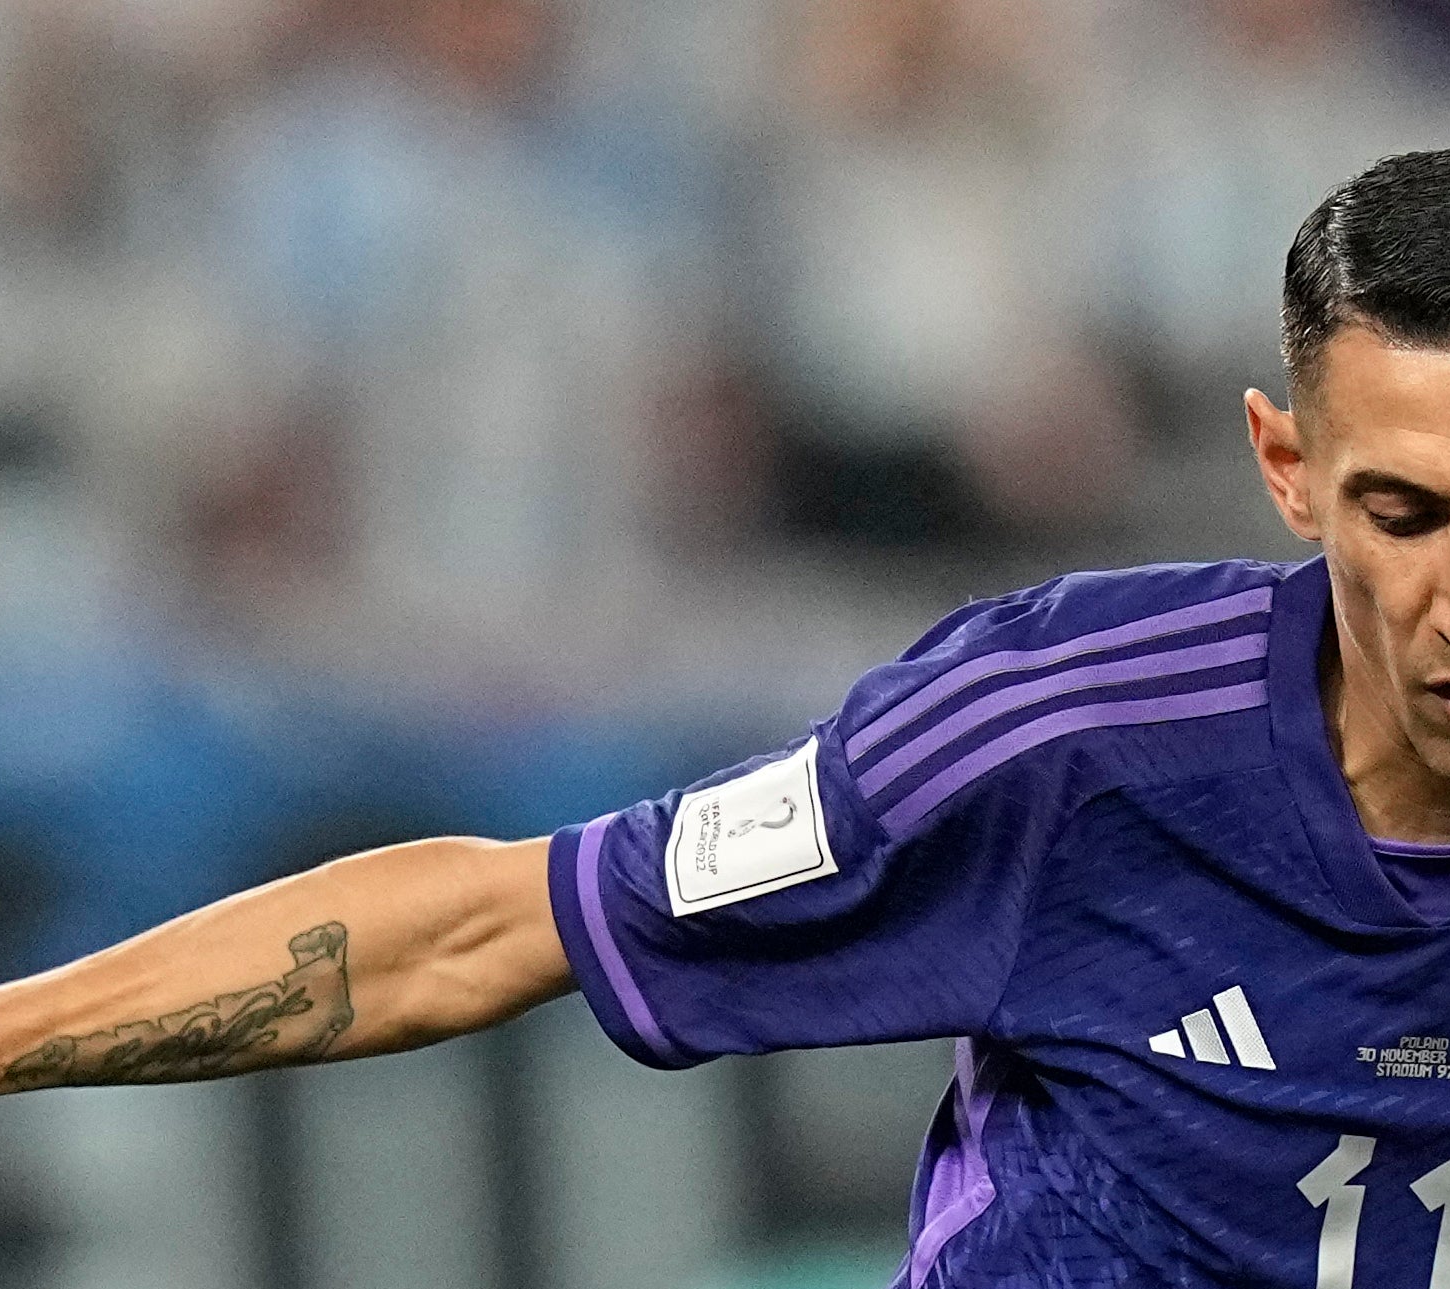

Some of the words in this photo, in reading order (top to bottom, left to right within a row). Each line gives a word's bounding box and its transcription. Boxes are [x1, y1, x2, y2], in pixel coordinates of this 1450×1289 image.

[707, 852, 719, 875] CUP
[1399, 1036, 1450, 1051] POLAND
[1356, 1047, 1377, 1062] 30
[1379, 1048, 1448, 1064] NOVEMBER
[1376, 1063, 1433, 1079] STADIUM
